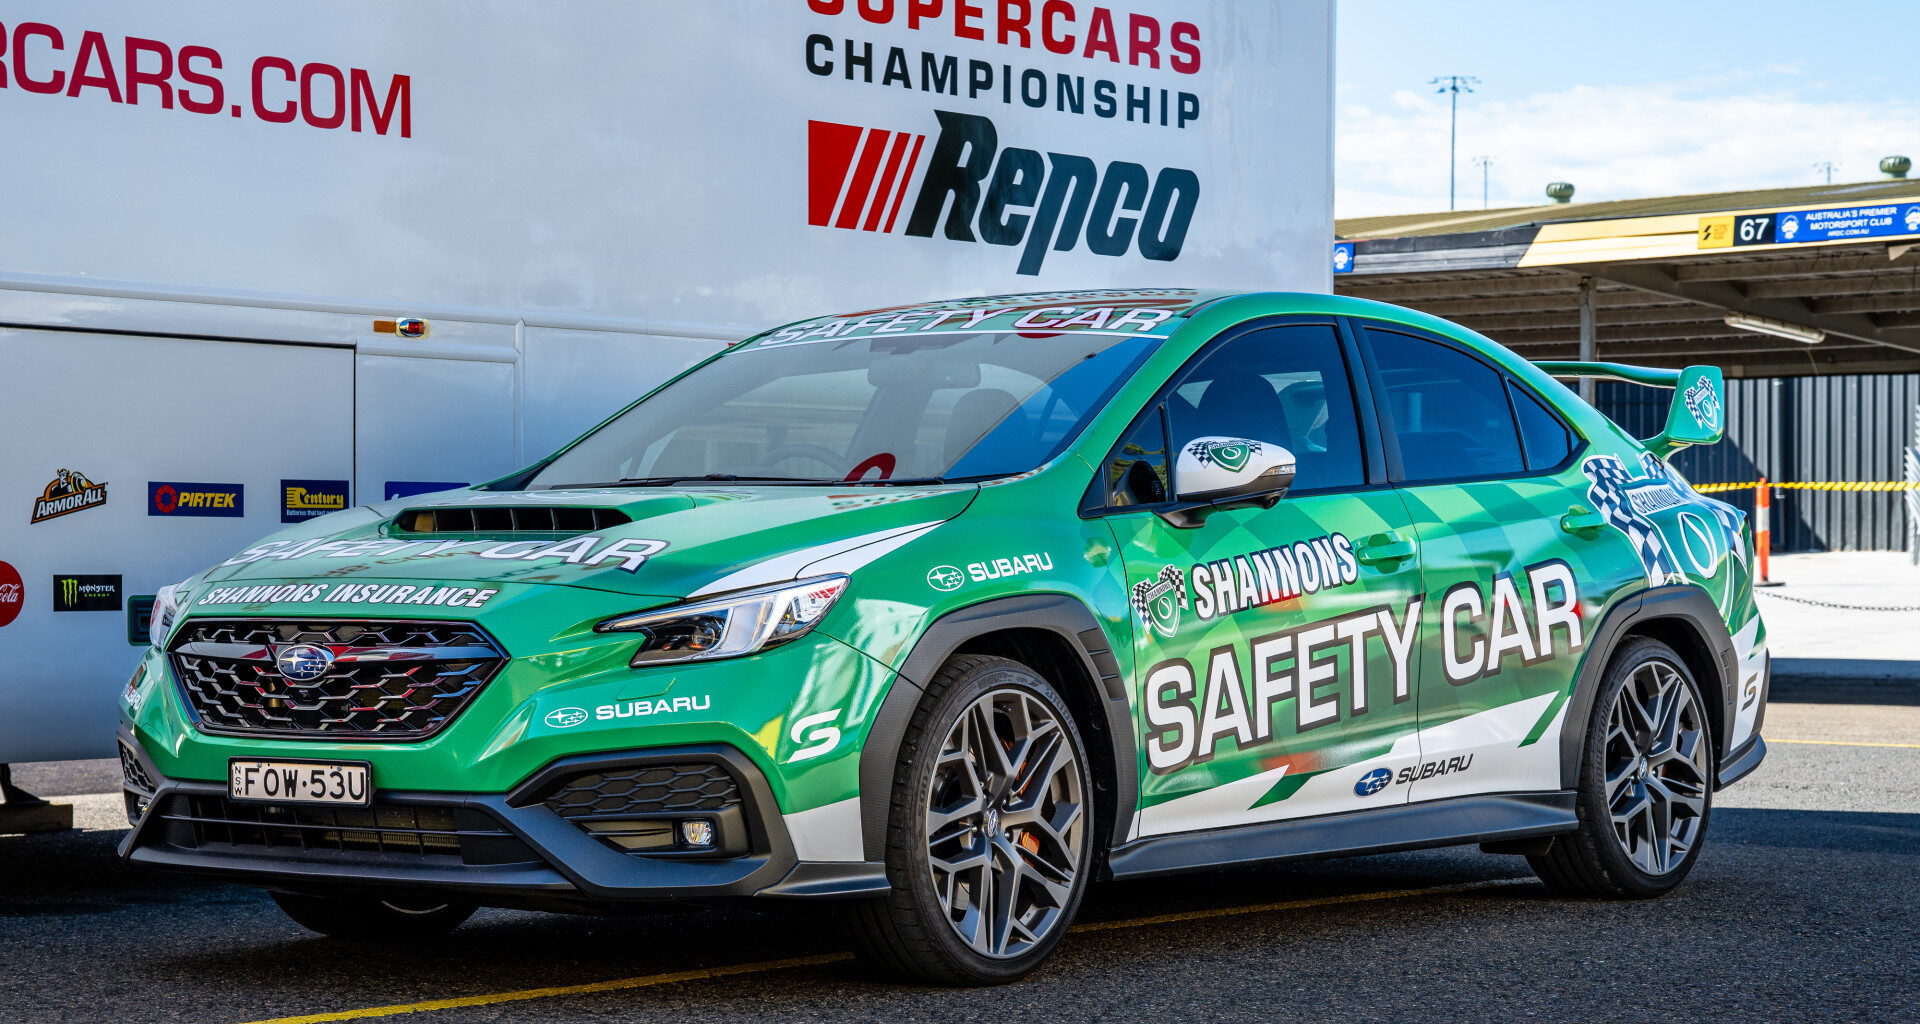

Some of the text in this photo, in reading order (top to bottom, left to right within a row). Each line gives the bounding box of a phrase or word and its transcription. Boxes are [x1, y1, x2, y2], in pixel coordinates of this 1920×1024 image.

[807, 0, 1200, 75] PERCARS
[0, 20, 411, 138] CARS.COM
[805, 33, 1200, 129] CHAMPIONSHIP
[904, 109, 1200, 277] Repco
[1805, 206, 1897, 220] AUSTRALIA'S PREMIER
[1810, 217, 1892, 230] MOTORSPORT CLUB
[1740, 218, 1769, 241] 67
[763, 306, 1177, 346] SAFETY CAR
[178, 492, 236, 508] PIRTEK
[287, 487, 343, 508] Century
[219, 538, 492, 567] SAFETY
[477, 537, 671, 573] CAR
[967, 552, 1053, 582] SUBARU
[78, 585, 116, 593] MONSTER
[1191, 532, 1359, 621] SHANNONS
[198, 583, 500, 608] SHANNONS INSURANCE
[1144, 557, 1585, 775] SAFETY CAR
[595, 694, 710, 721] SUBARU
[1395, 753, 1474, 785] SUBARU
